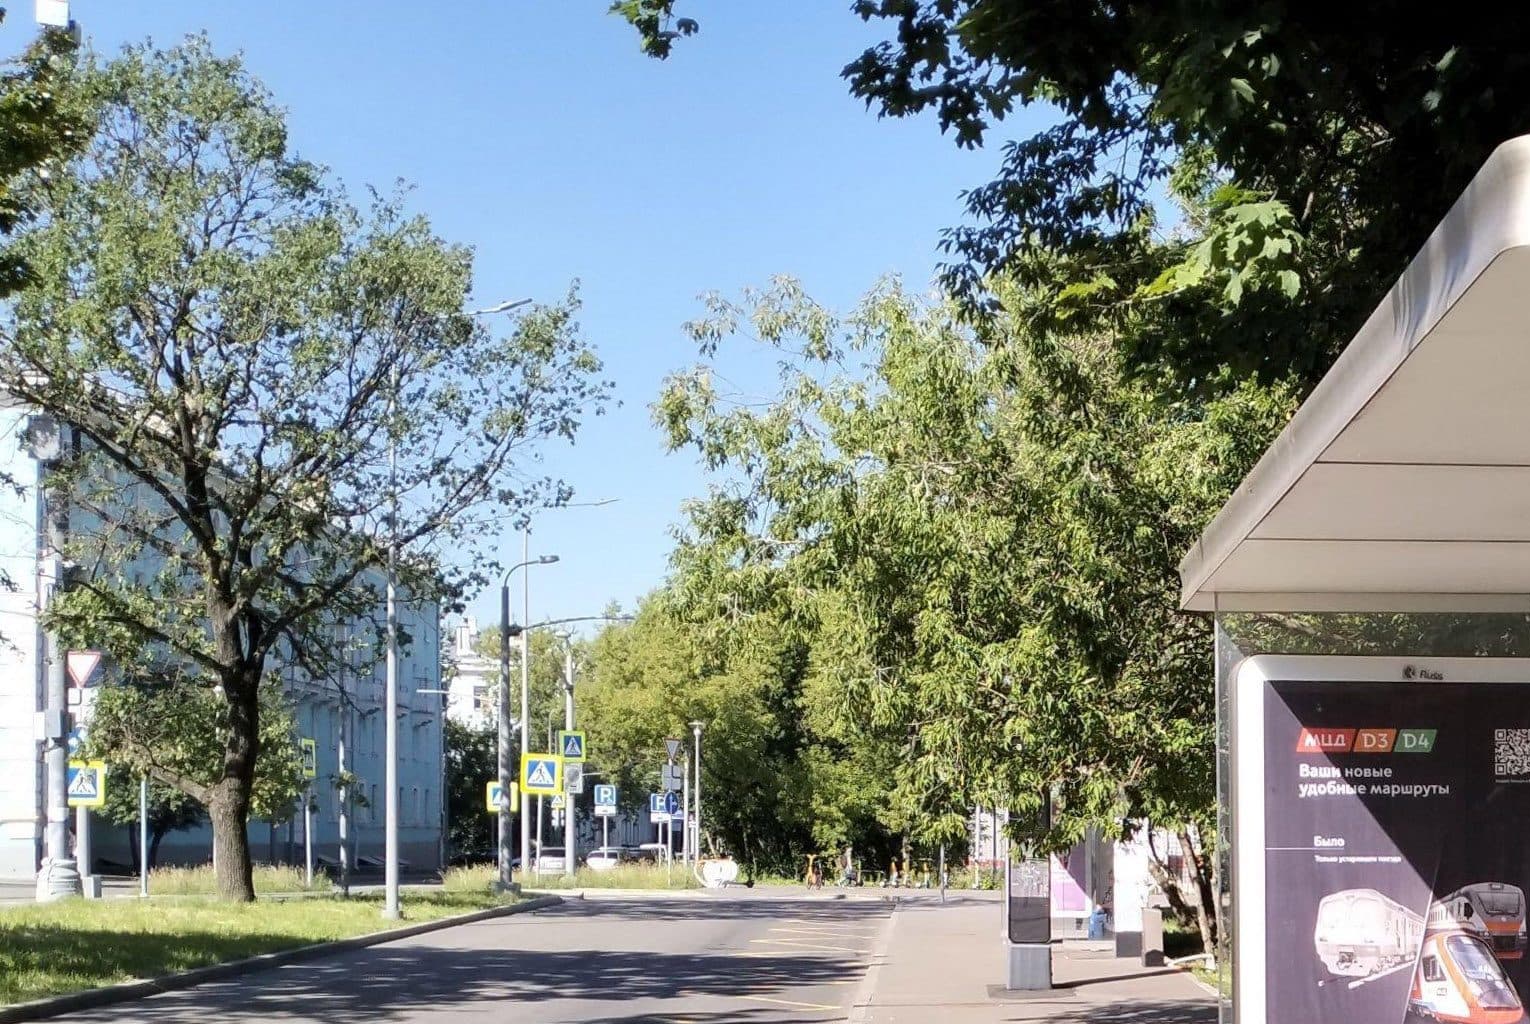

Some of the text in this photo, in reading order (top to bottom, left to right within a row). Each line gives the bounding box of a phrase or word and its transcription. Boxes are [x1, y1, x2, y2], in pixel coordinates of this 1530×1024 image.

[1361, 733, 1388, 748] D3
[1403, 733, 1430, 748] D4
[1299, 763, 1393, 778] Ваши новые
[1298, 780, 1450, 798] удобные маршруты
[1313, 835, 1345, 847] Было
